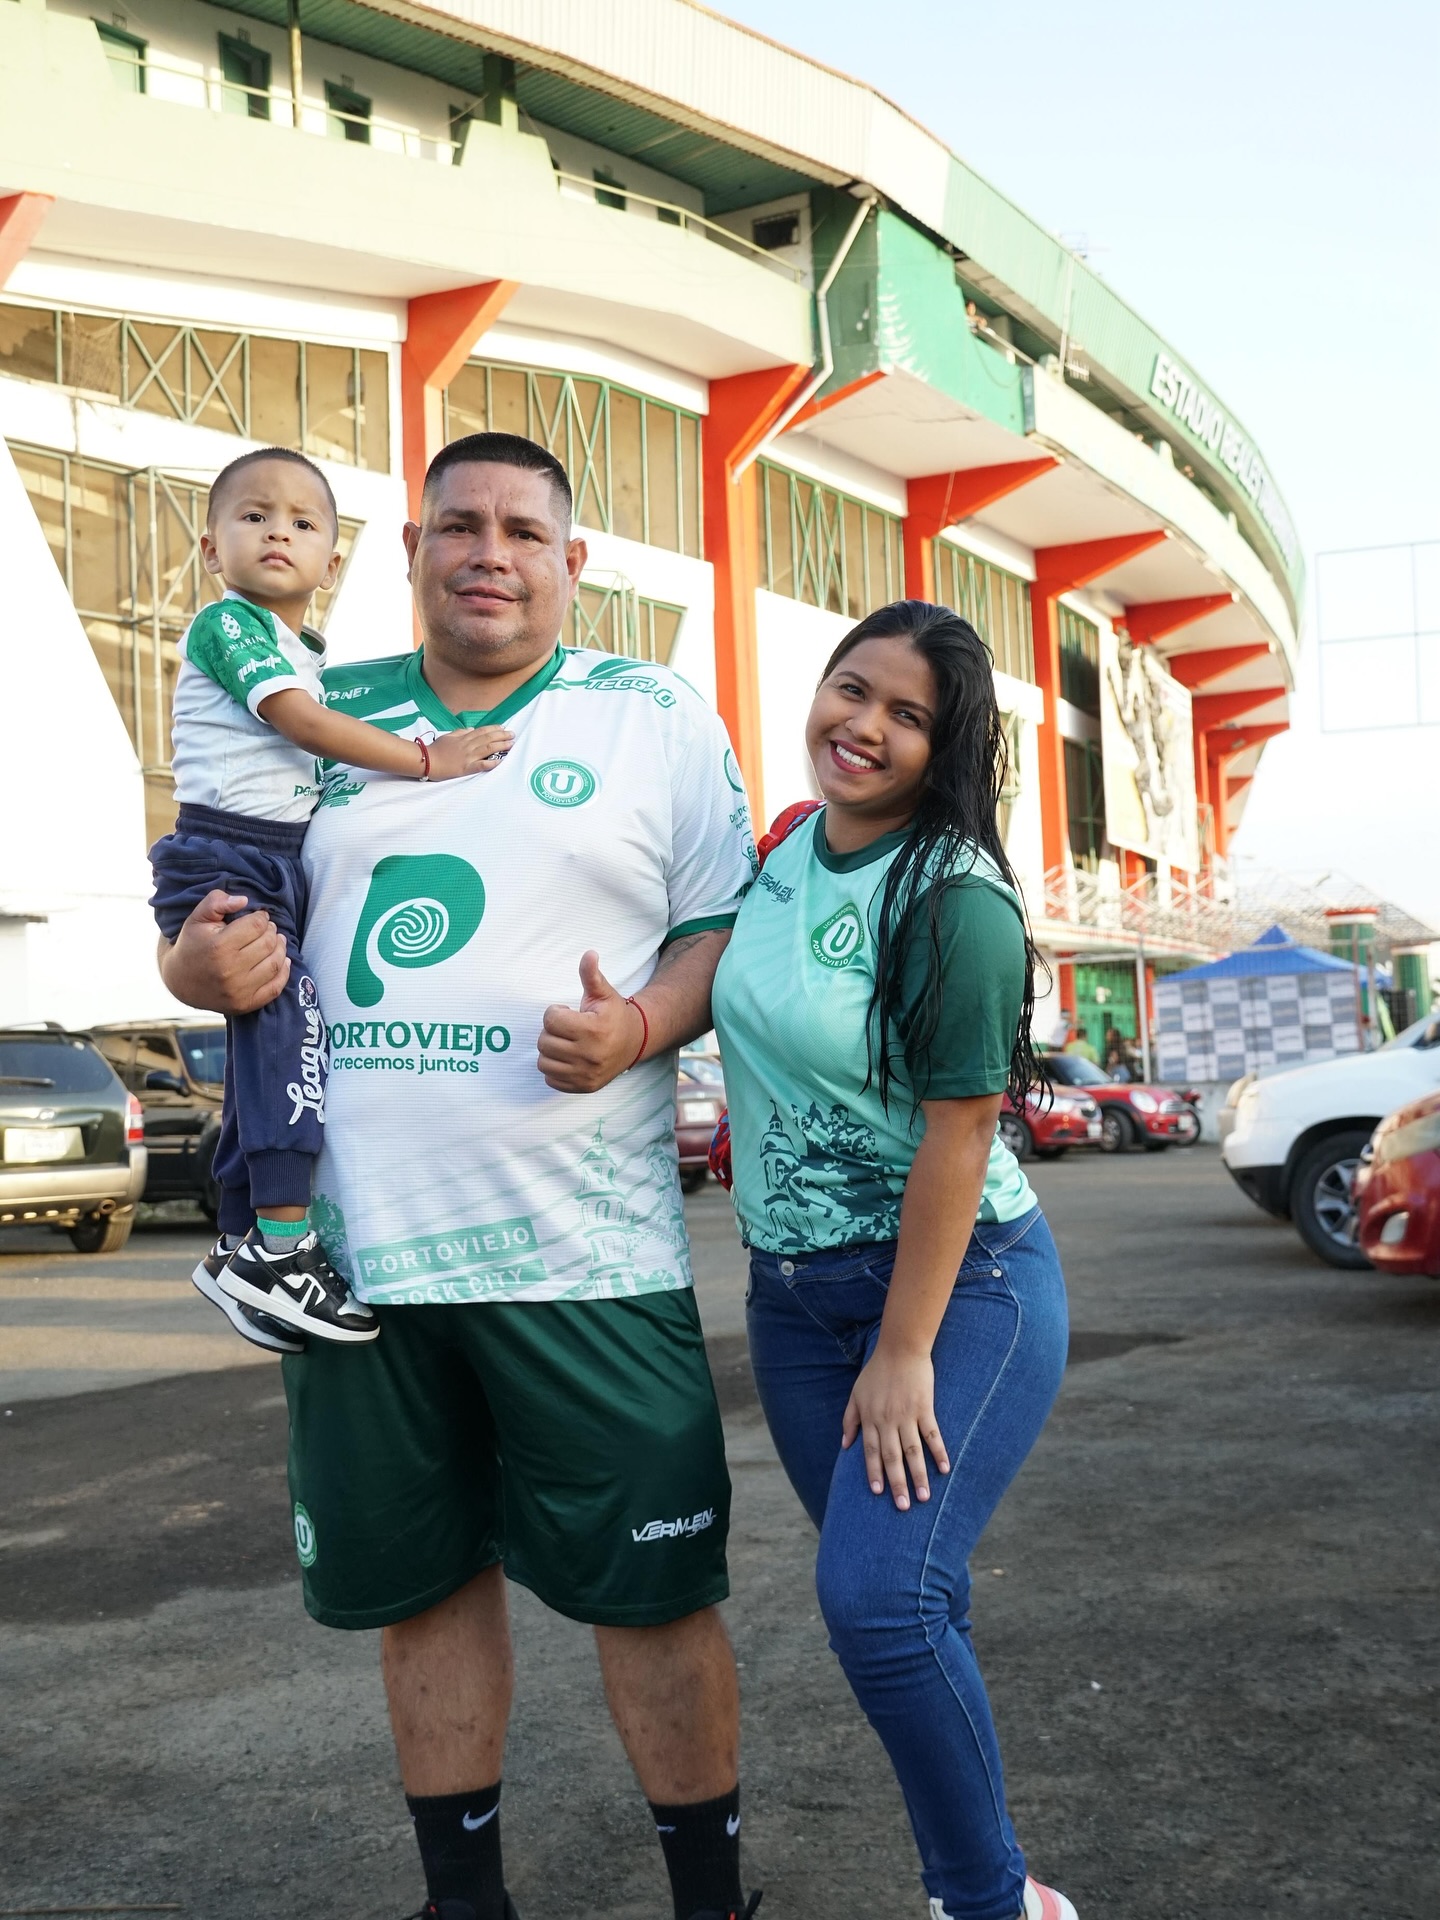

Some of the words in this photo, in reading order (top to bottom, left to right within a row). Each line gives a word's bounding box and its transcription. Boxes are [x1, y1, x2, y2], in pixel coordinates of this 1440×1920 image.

[1150, 352, 1224, 452] ESTADIO
[550, 772, 576, 794] U
[829, 922, 856, 953] U
[812, 939, 849, 967] PORTOVIEJO
[333, 1057, 415, 1071] crecemos
[417, 1054, 480, 1075] juntos
[363, 1226, 530, 1278] PORTOVIEJO
[467, 1266, 523, 1294] CITY
[631, 1507, 714, 1542] VERMEN
